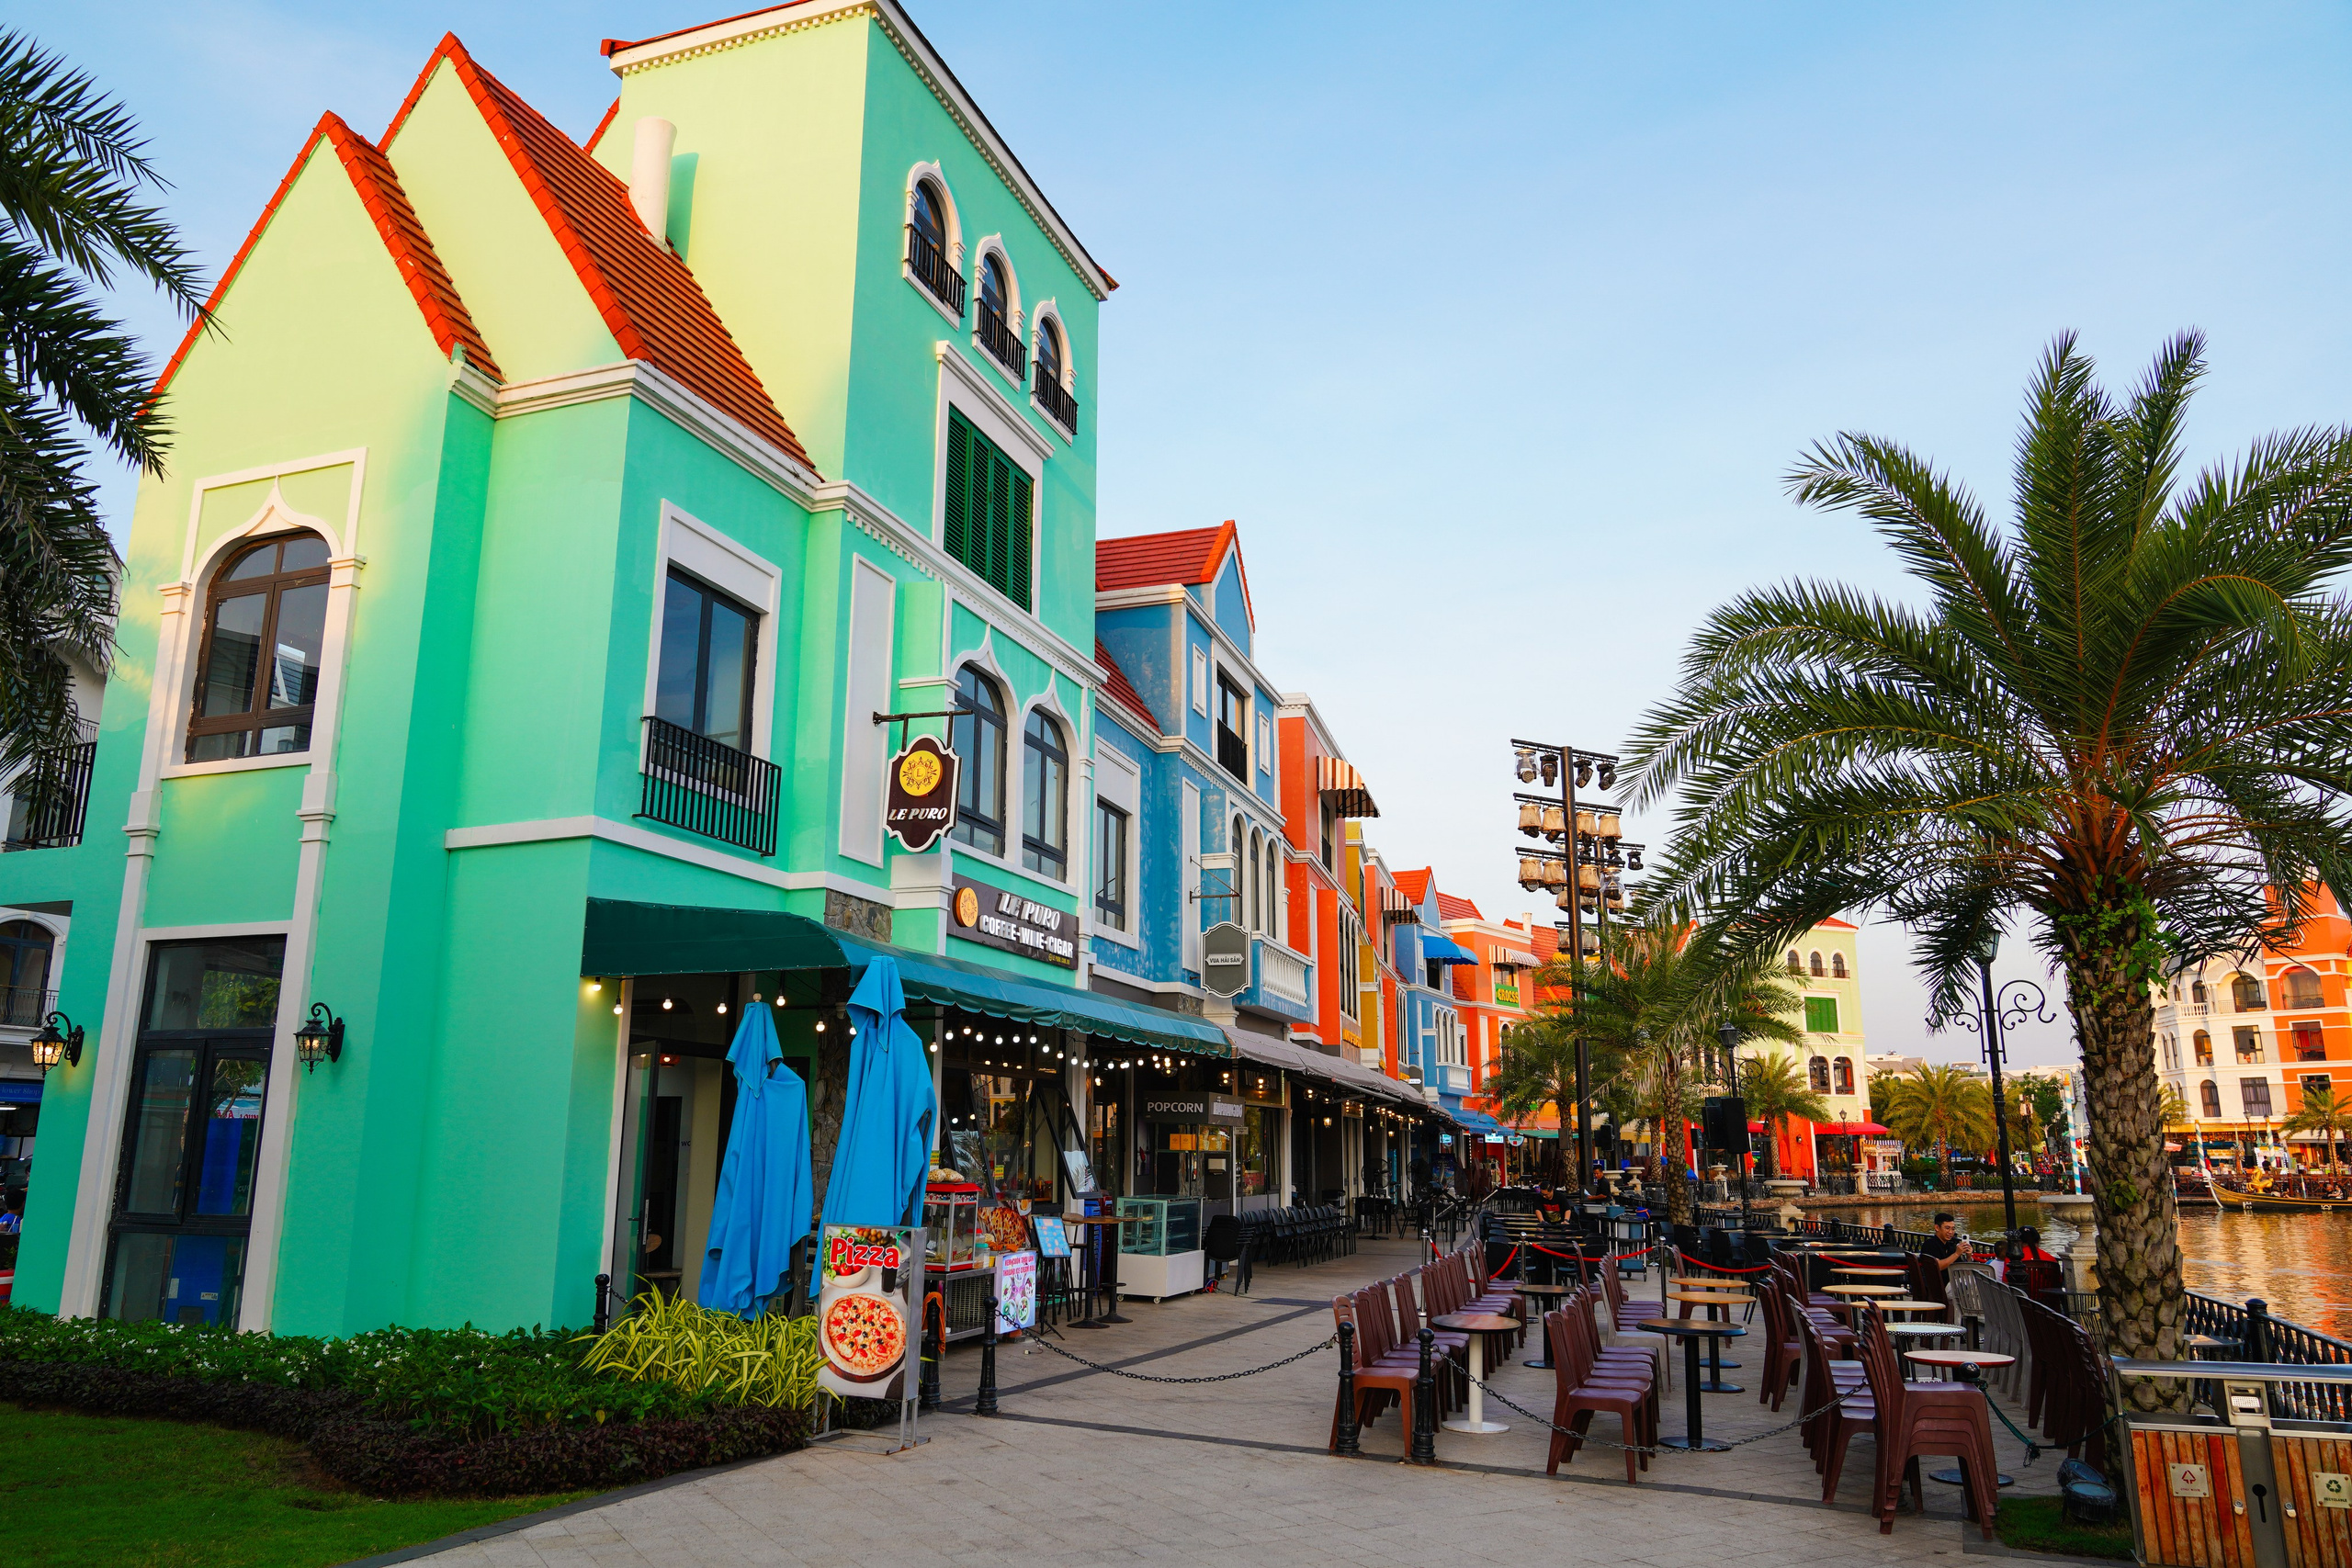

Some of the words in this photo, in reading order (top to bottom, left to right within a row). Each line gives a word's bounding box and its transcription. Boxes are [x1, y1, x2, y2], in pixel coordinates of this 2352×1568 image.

[888, 808, 909, 820] LE
[908, 807, 948, 820] PURO
[998, 892, 1023, 917] LE
[1021, 900, 1060, 931] PURO
[0, 1085, 22, 1094] lower
[22, 1087, 40, 1096] Shop
[1147, 1101, 1204, 1112] POPCORN
[830, 1236, 900, 1269] Pizza
